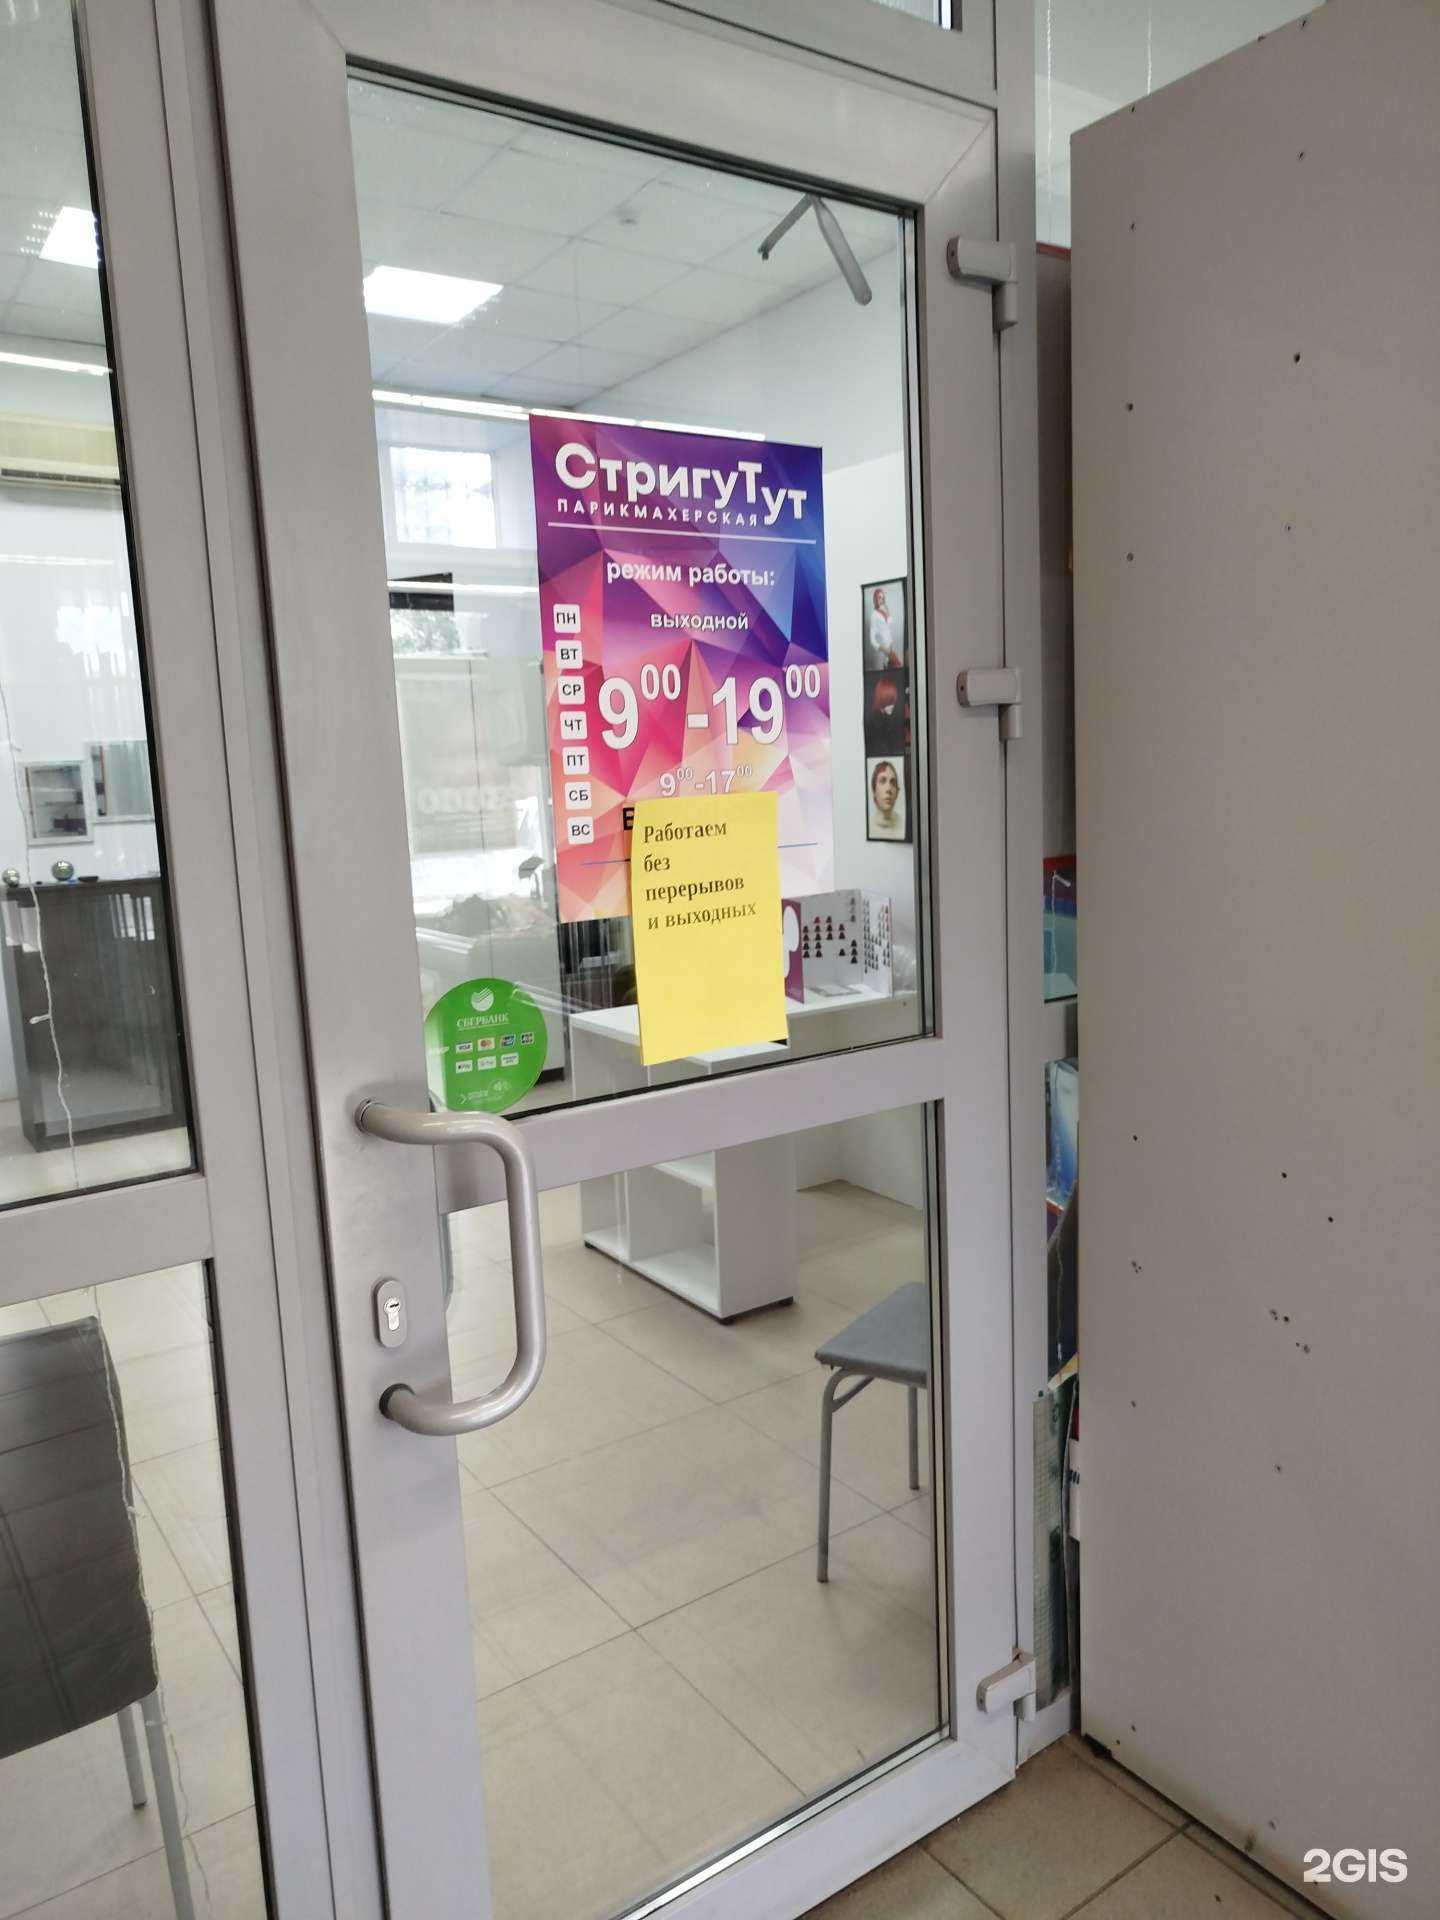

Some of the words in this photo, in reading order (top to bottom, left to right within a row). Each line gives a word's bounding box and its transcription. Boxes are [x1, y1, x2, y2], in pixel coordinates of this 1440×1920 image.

[557, 498, 757, 527] ПАРИКМАХЕРСКАЯ
[607, 561, 681, 584] режим
[689, 563, 775, 588] работы:
[556, 611, 577, 625] ПН
[650, 612, 749, 631] выходной
[560, 648, 579, 661] ВТ
[562, 683, 582, 697] СР
[564, 718, 583, 732] ЧТ
[566, 754, 586, 768] ПТ
[568, 788, 589, 802] СБ
[571, 824, 591, 837] ВС
[643, 821, 728, 844] Работаем
[643, 853, 671, 873] без
[646, 876, 745, 903] перерывов
[647, 916, 659, 930] и
[665, 902, 757, 927] выходных
[456, 1012, 510, 1028] СБЕРБАНК
